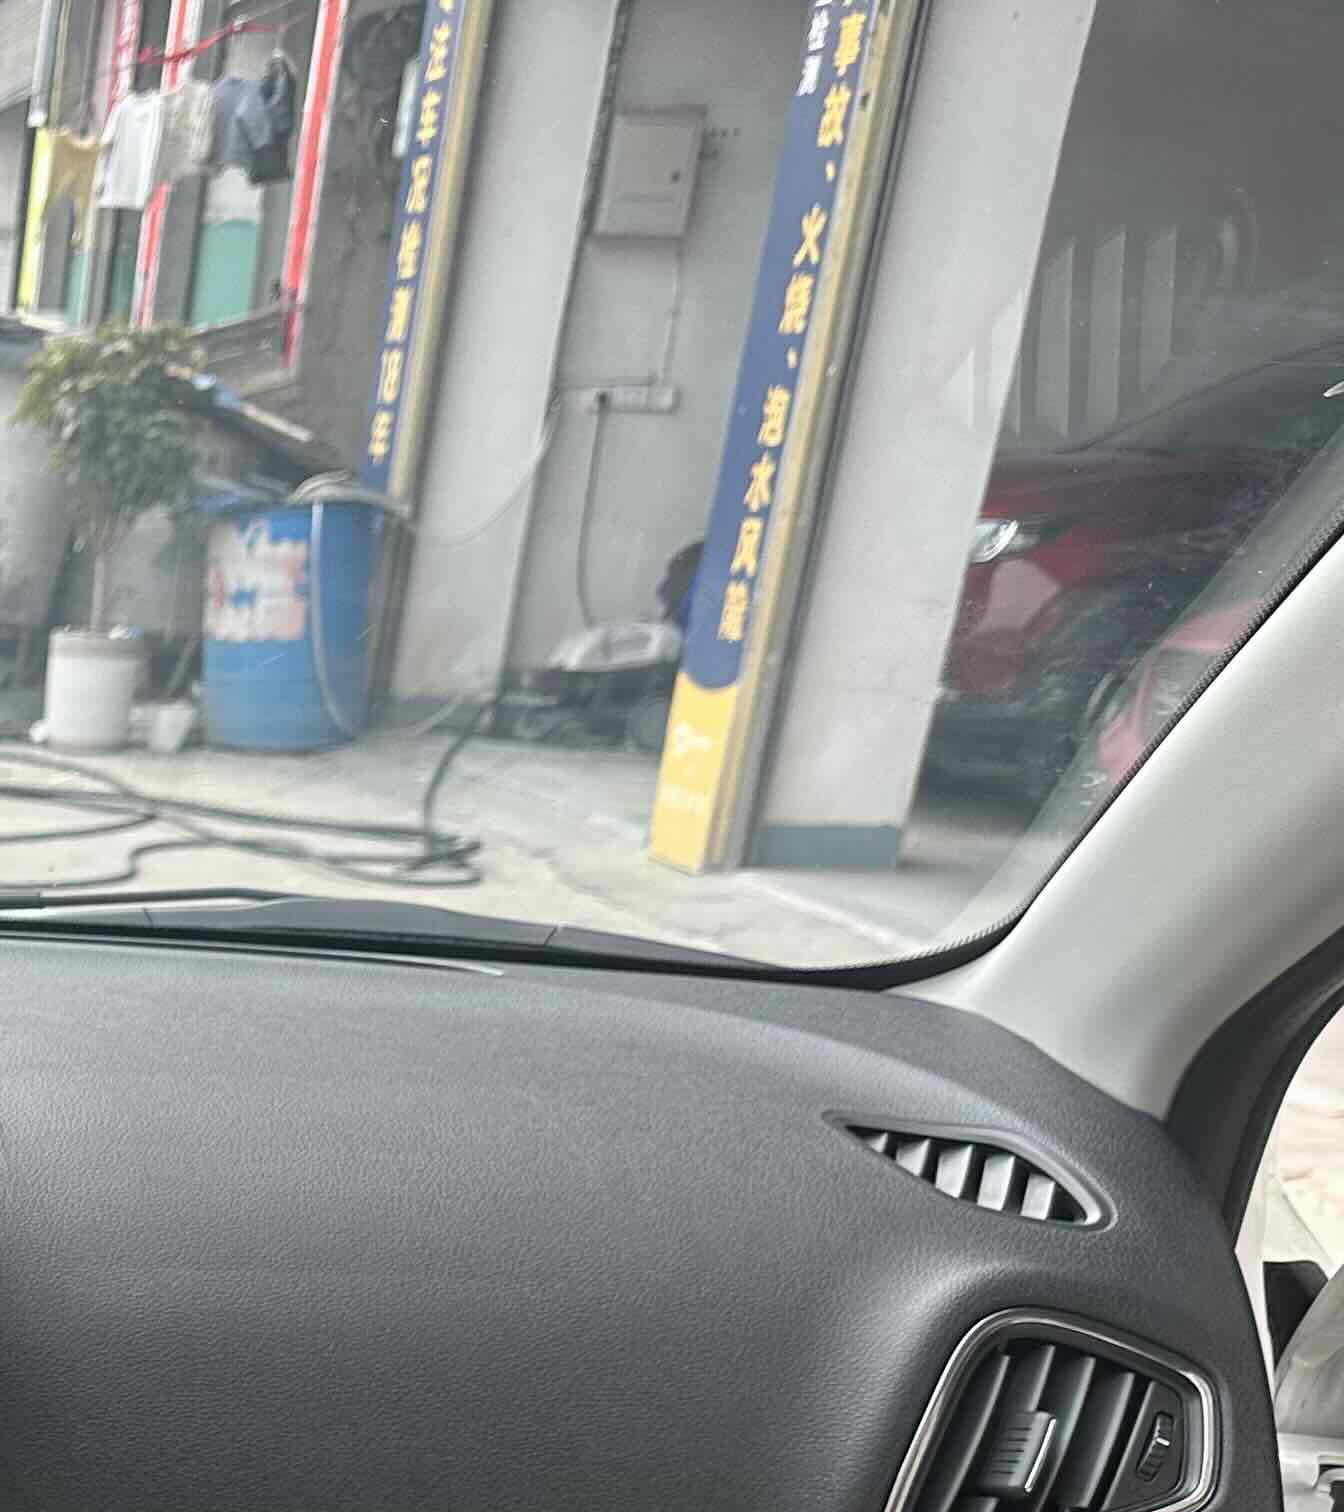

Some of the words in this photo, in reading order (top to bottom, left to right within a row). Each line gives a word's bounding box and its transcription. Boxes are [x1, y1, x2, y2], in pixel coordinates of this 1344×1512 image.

[796, 0, 834, 96] 检测
[716, 0, 866, 641] 事故、火烧、泡水风险
